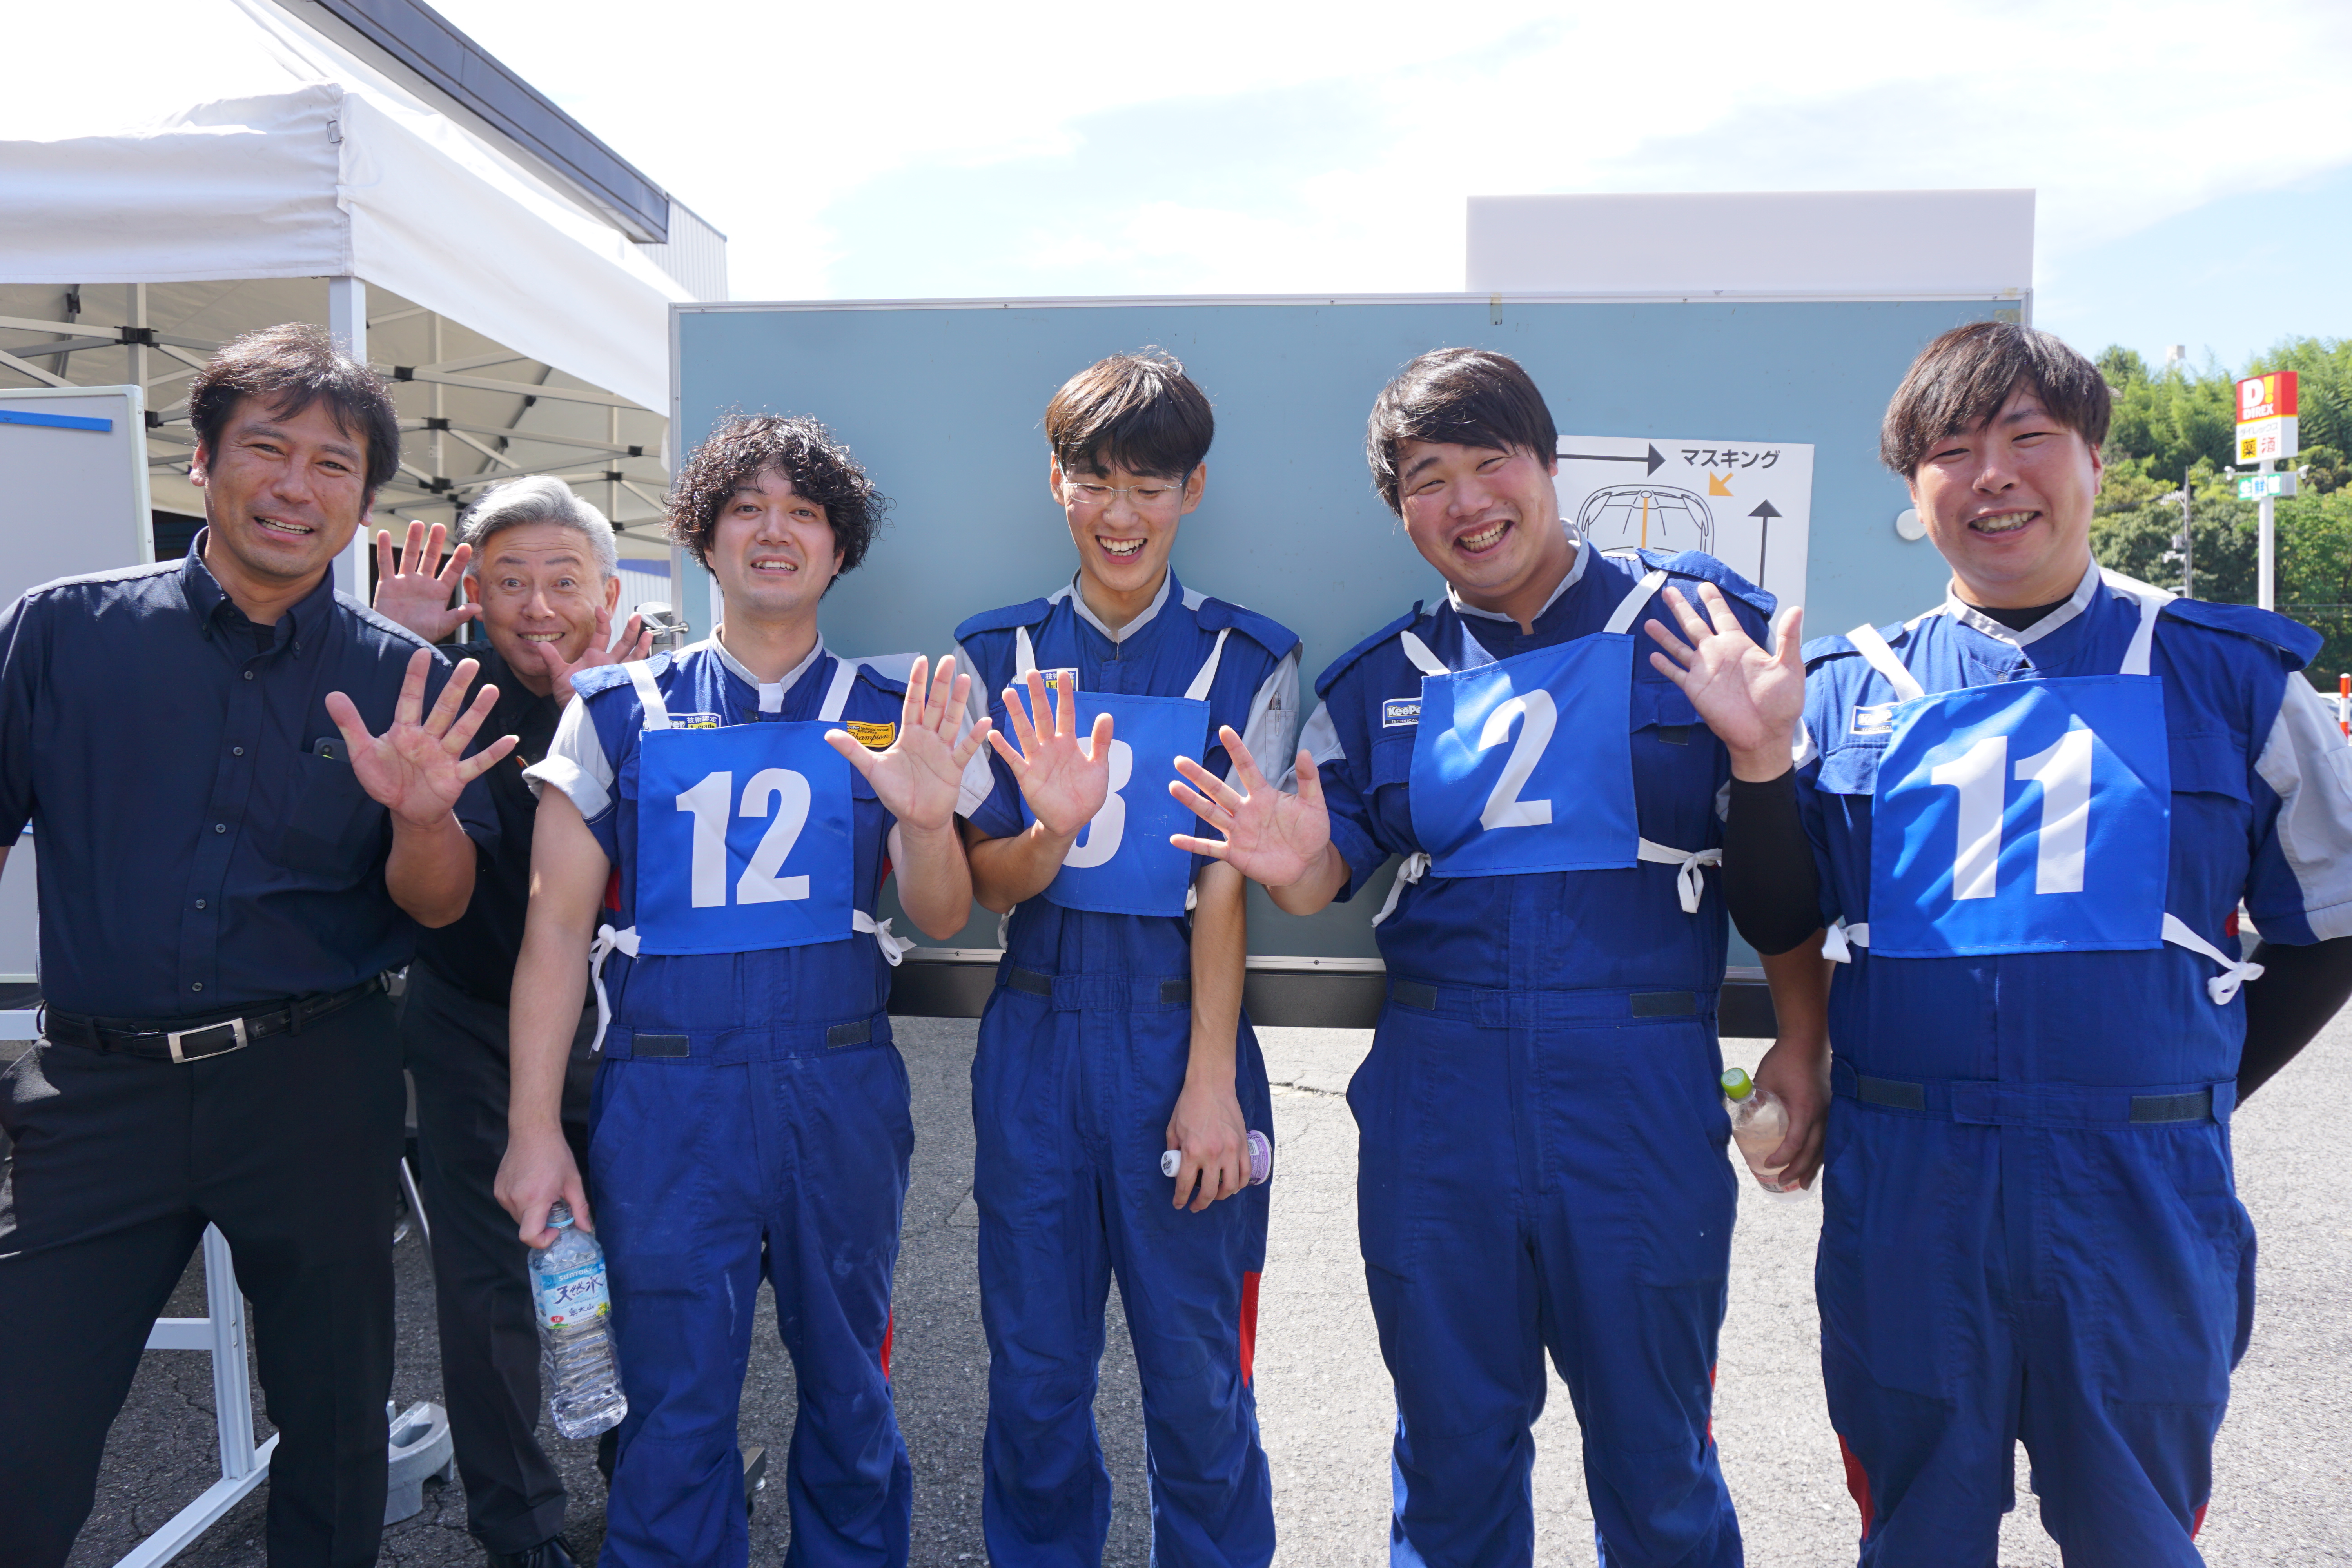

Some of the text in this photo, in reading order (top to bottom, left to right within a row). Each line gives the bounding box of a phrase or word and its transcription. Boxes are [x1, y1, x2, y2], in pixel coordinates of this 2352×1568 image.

[2243, 403, 2274, 420] DIREX
[2240, 422, 2278, 437] ダイレックス
[2261, 437, 2276, 454] 酒
[1681, 449, 1781, 469] マスキング
[1388, 705, 1421, 716] KeePe
[1478, 689, 1557, 831] 2
[1931, 729, 2093, 900] 11
[676, 768, 811, 908] 12
[558, 1267, 593, 1281] SUNTORY
[553, 1276, 603, 1305] 天然水
